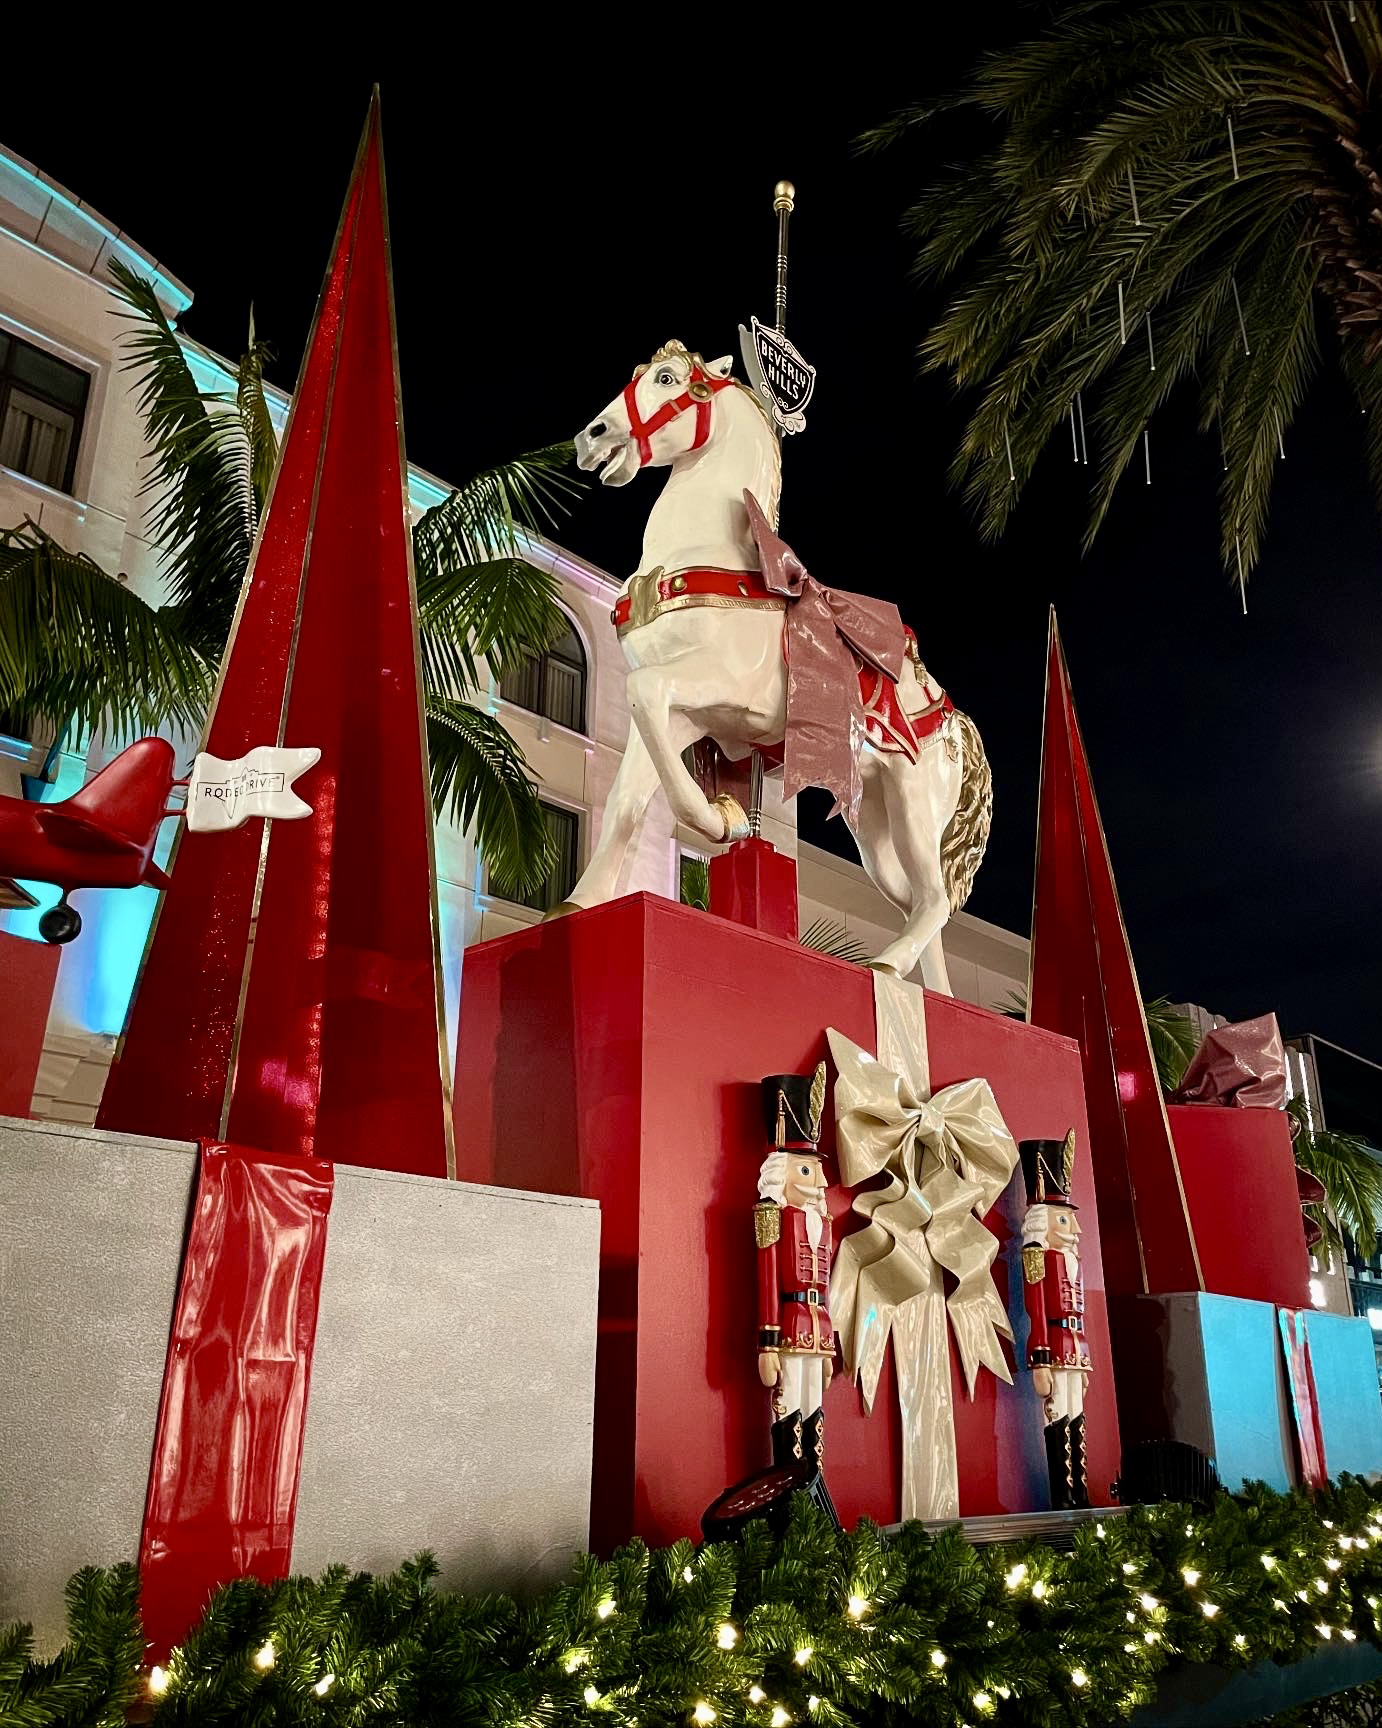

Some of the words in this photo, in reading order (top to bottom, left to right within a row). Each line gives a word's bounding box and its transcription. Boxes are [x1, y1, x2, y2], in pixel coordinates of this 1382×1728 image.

[761, 340, 806, 388] BEVERLY
[768, 363, 799, 400] HILLS
[204, 785, 244, 798] RODEO
